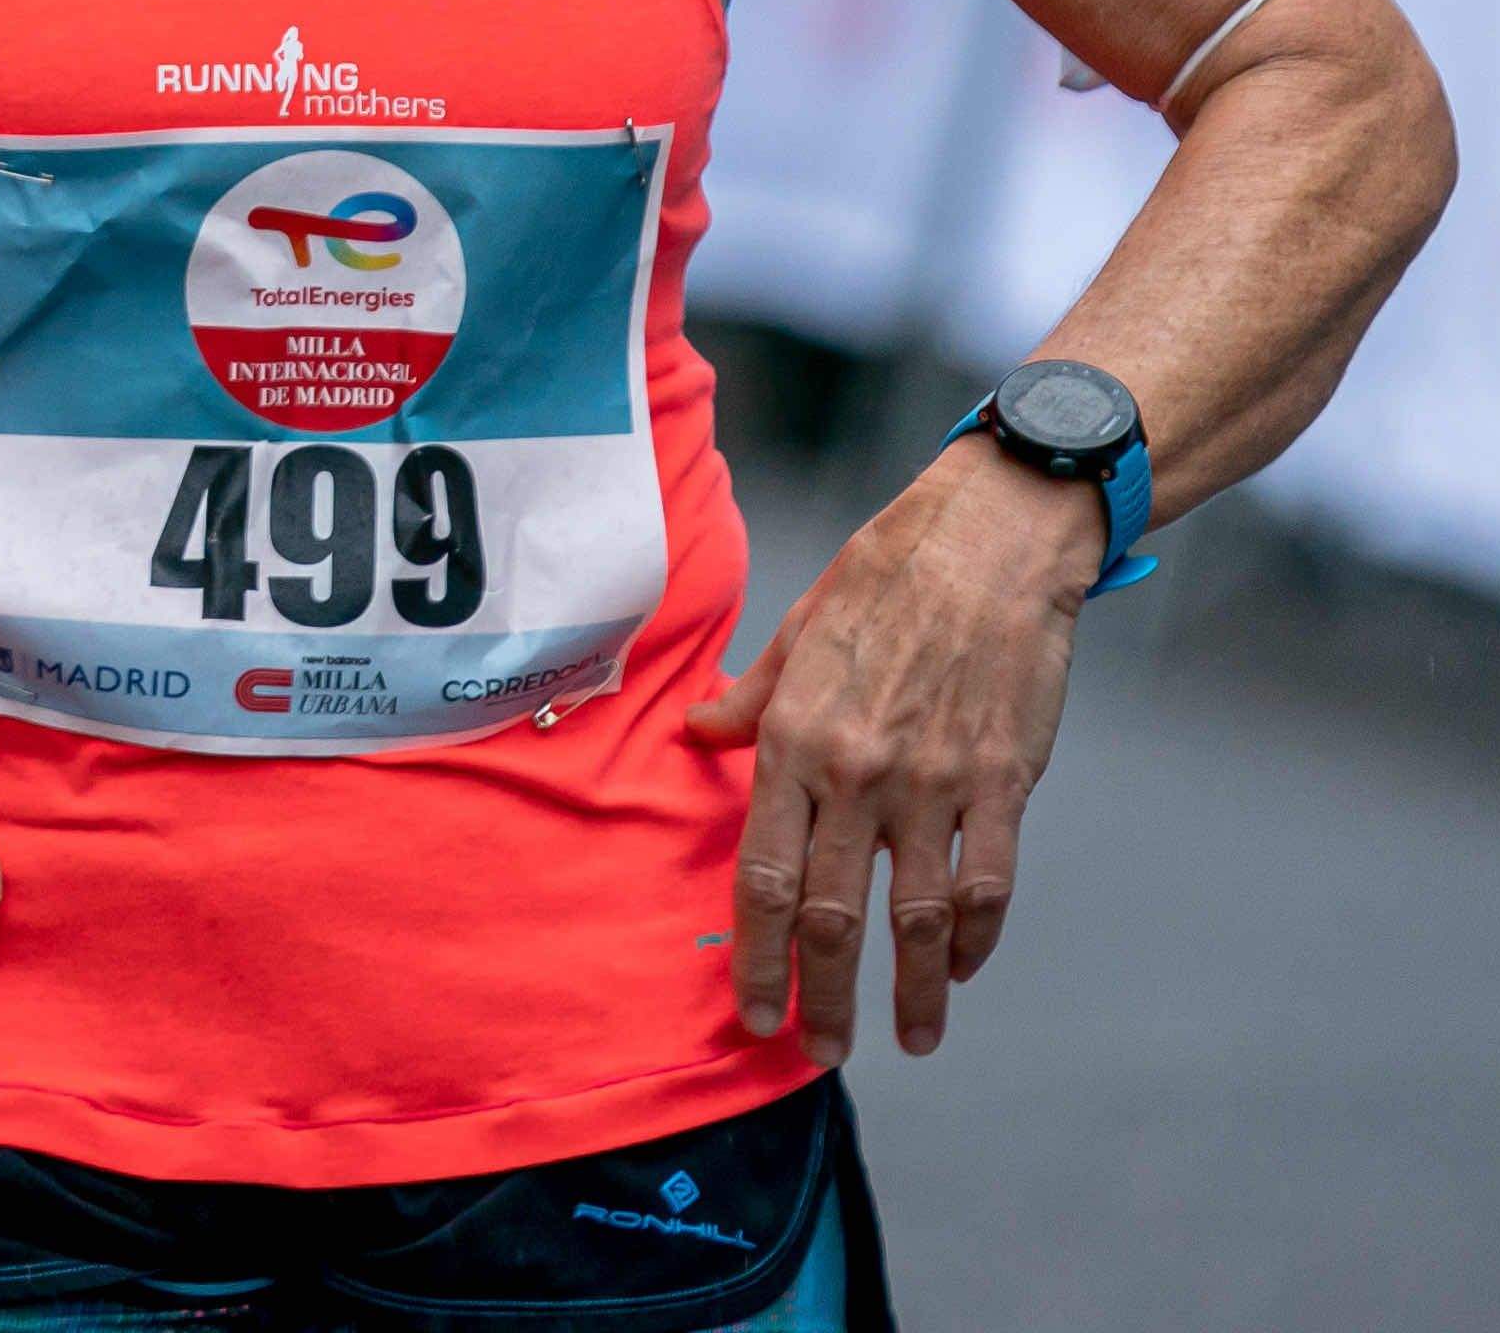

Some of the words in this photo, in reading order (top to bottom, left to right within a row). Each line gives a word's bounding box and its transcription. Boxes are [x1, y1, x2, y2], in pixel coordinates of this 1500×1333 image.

[304, 89, 447, 119] mothers
[251, 285, 416, 311] TotalEnergies
[286, 336, 366, 357] MILLA
[258, 386, 291, 408] DE
[294, 386, 396, 408] MADRID
[149, 442, 488, 629] 499
[36, 657, 192, 700] MADRID
[301, 669, 388, 691] MILLA
[298, 693, 400, 715] URBANA
[572, 1202, 757, 1250] RONHILL
